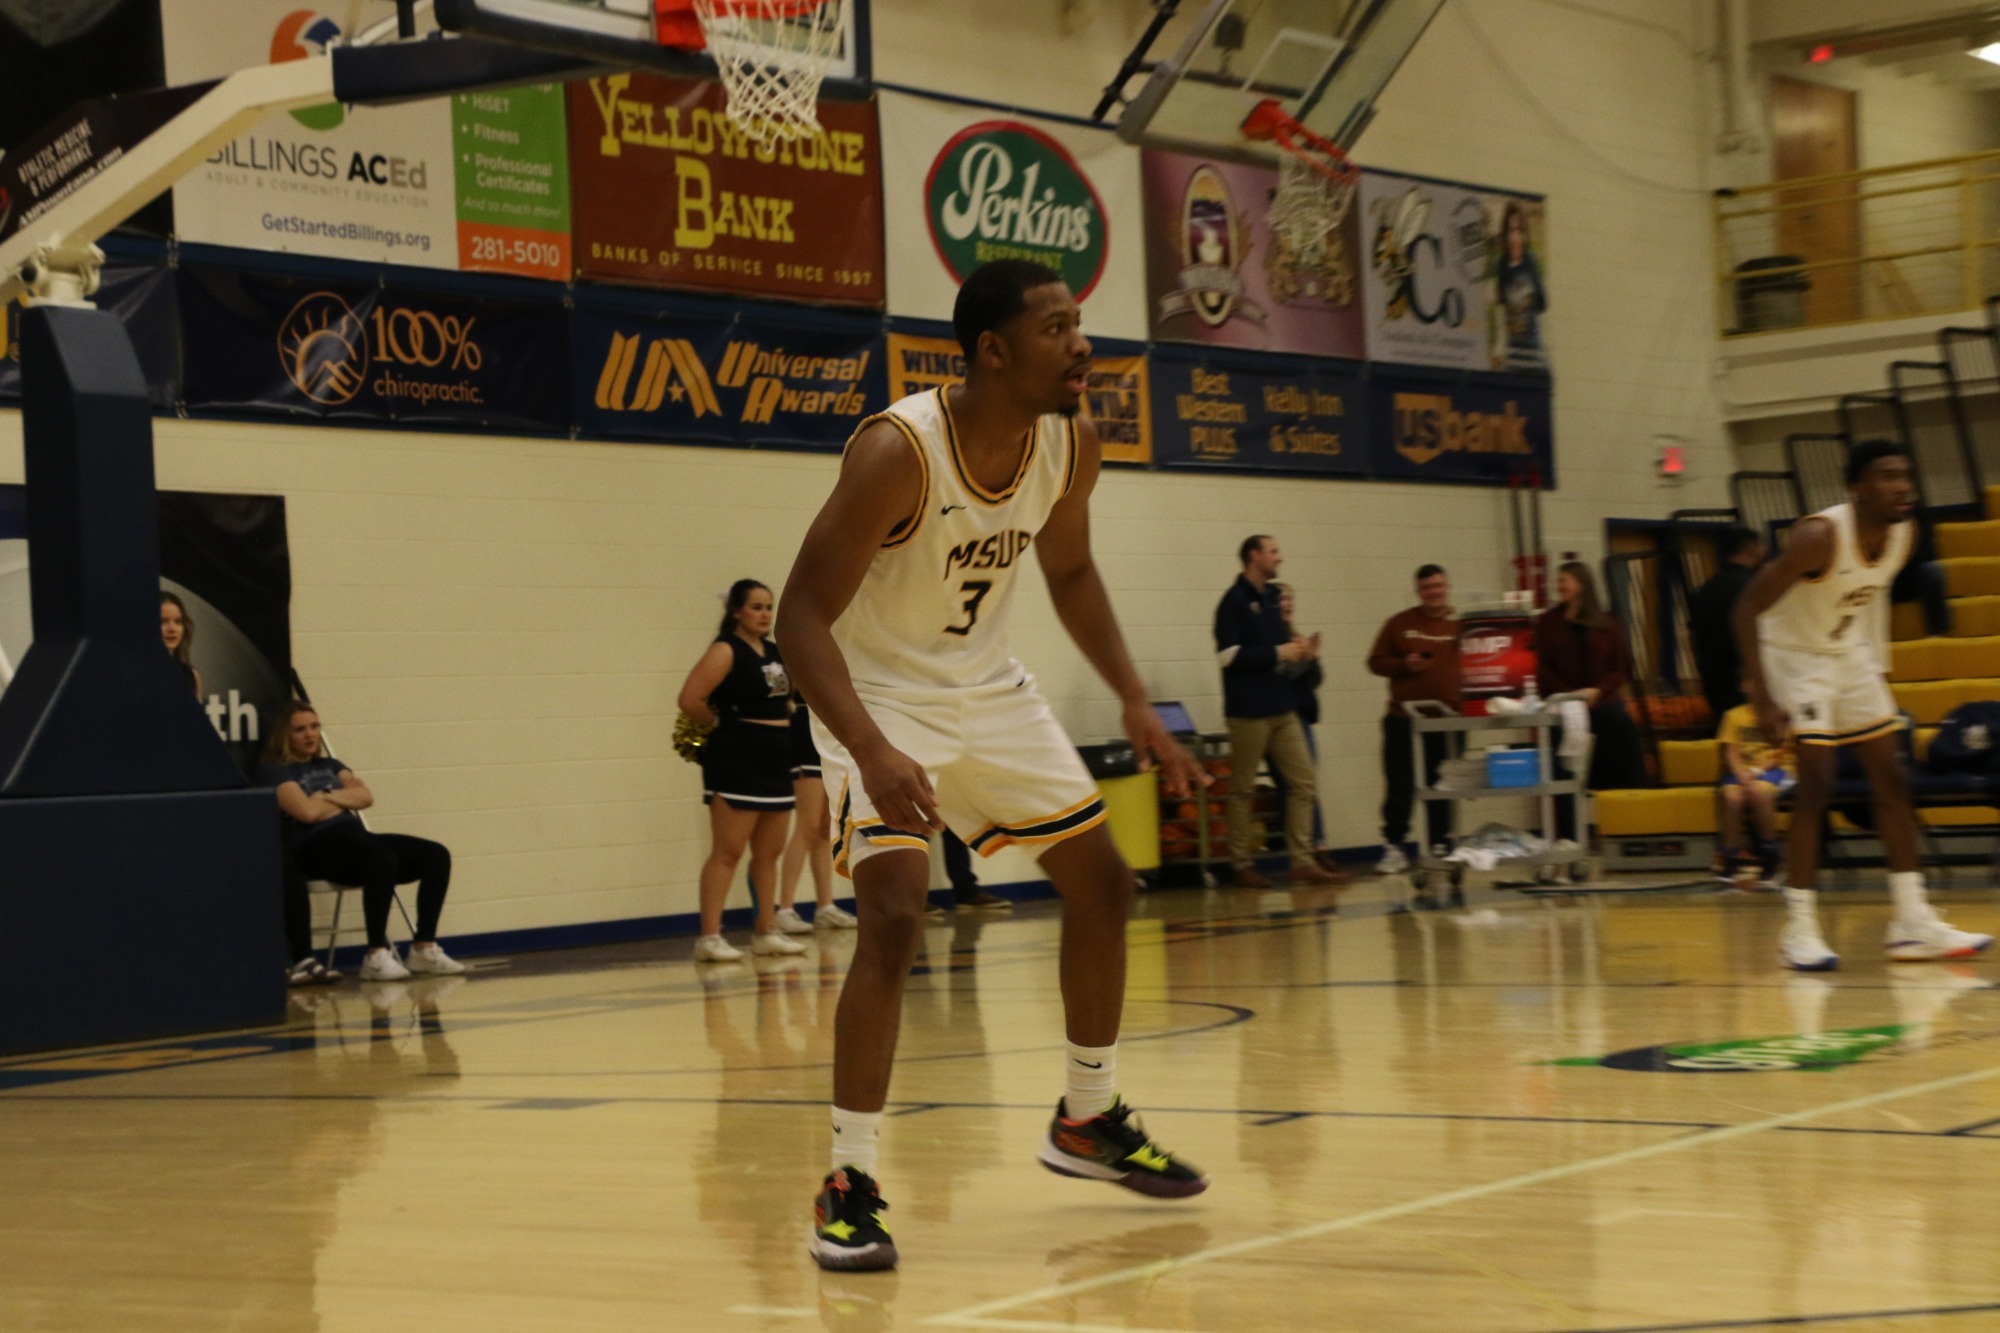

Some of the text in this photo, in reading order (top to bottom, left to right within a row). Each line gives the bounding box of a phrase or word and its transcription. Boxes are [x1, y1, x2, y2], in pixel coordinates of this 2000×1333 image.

[473, 122, 521, 146] Fitness
[589, 73, 865, 176] YELLOWSTONE
[17, 118, 93, 184] ATHLETIC MEDICINE
[475, 152, 554, 178] Professional
[347, 151, 428, 191] ACEd
[476, 170, 551, 196] Certificates
[270, 178, 349, 198] COMMUNITY
[356, 189, 430, 208] EDUCATION
[674, 156, 796, 249] BANK
[941, 141, 1091, 252] Perkins
[261, 213, 431, 251] GetStartedBillings.org
[471, 236, 561, 267] 281-5010
[591, 242, 649, 264] BANKS
[659, 250, 680, 267] OF
[694, 253, 763, 276] SERVICE
[776, 262, 824, 283] SINCE
[371, 305, 482, 371] 100%
[716, 340, 870, 387] Universal
[1191, 367, 1231, 395] Best
[741, 376, 866, 424] Awards
[1176, 394, 1248, 423] Western
[1190, 426, 1239, 453] PLUS
[1269, 424, 1342, 455] & Suites
[942, 581, 992, 636] 3
